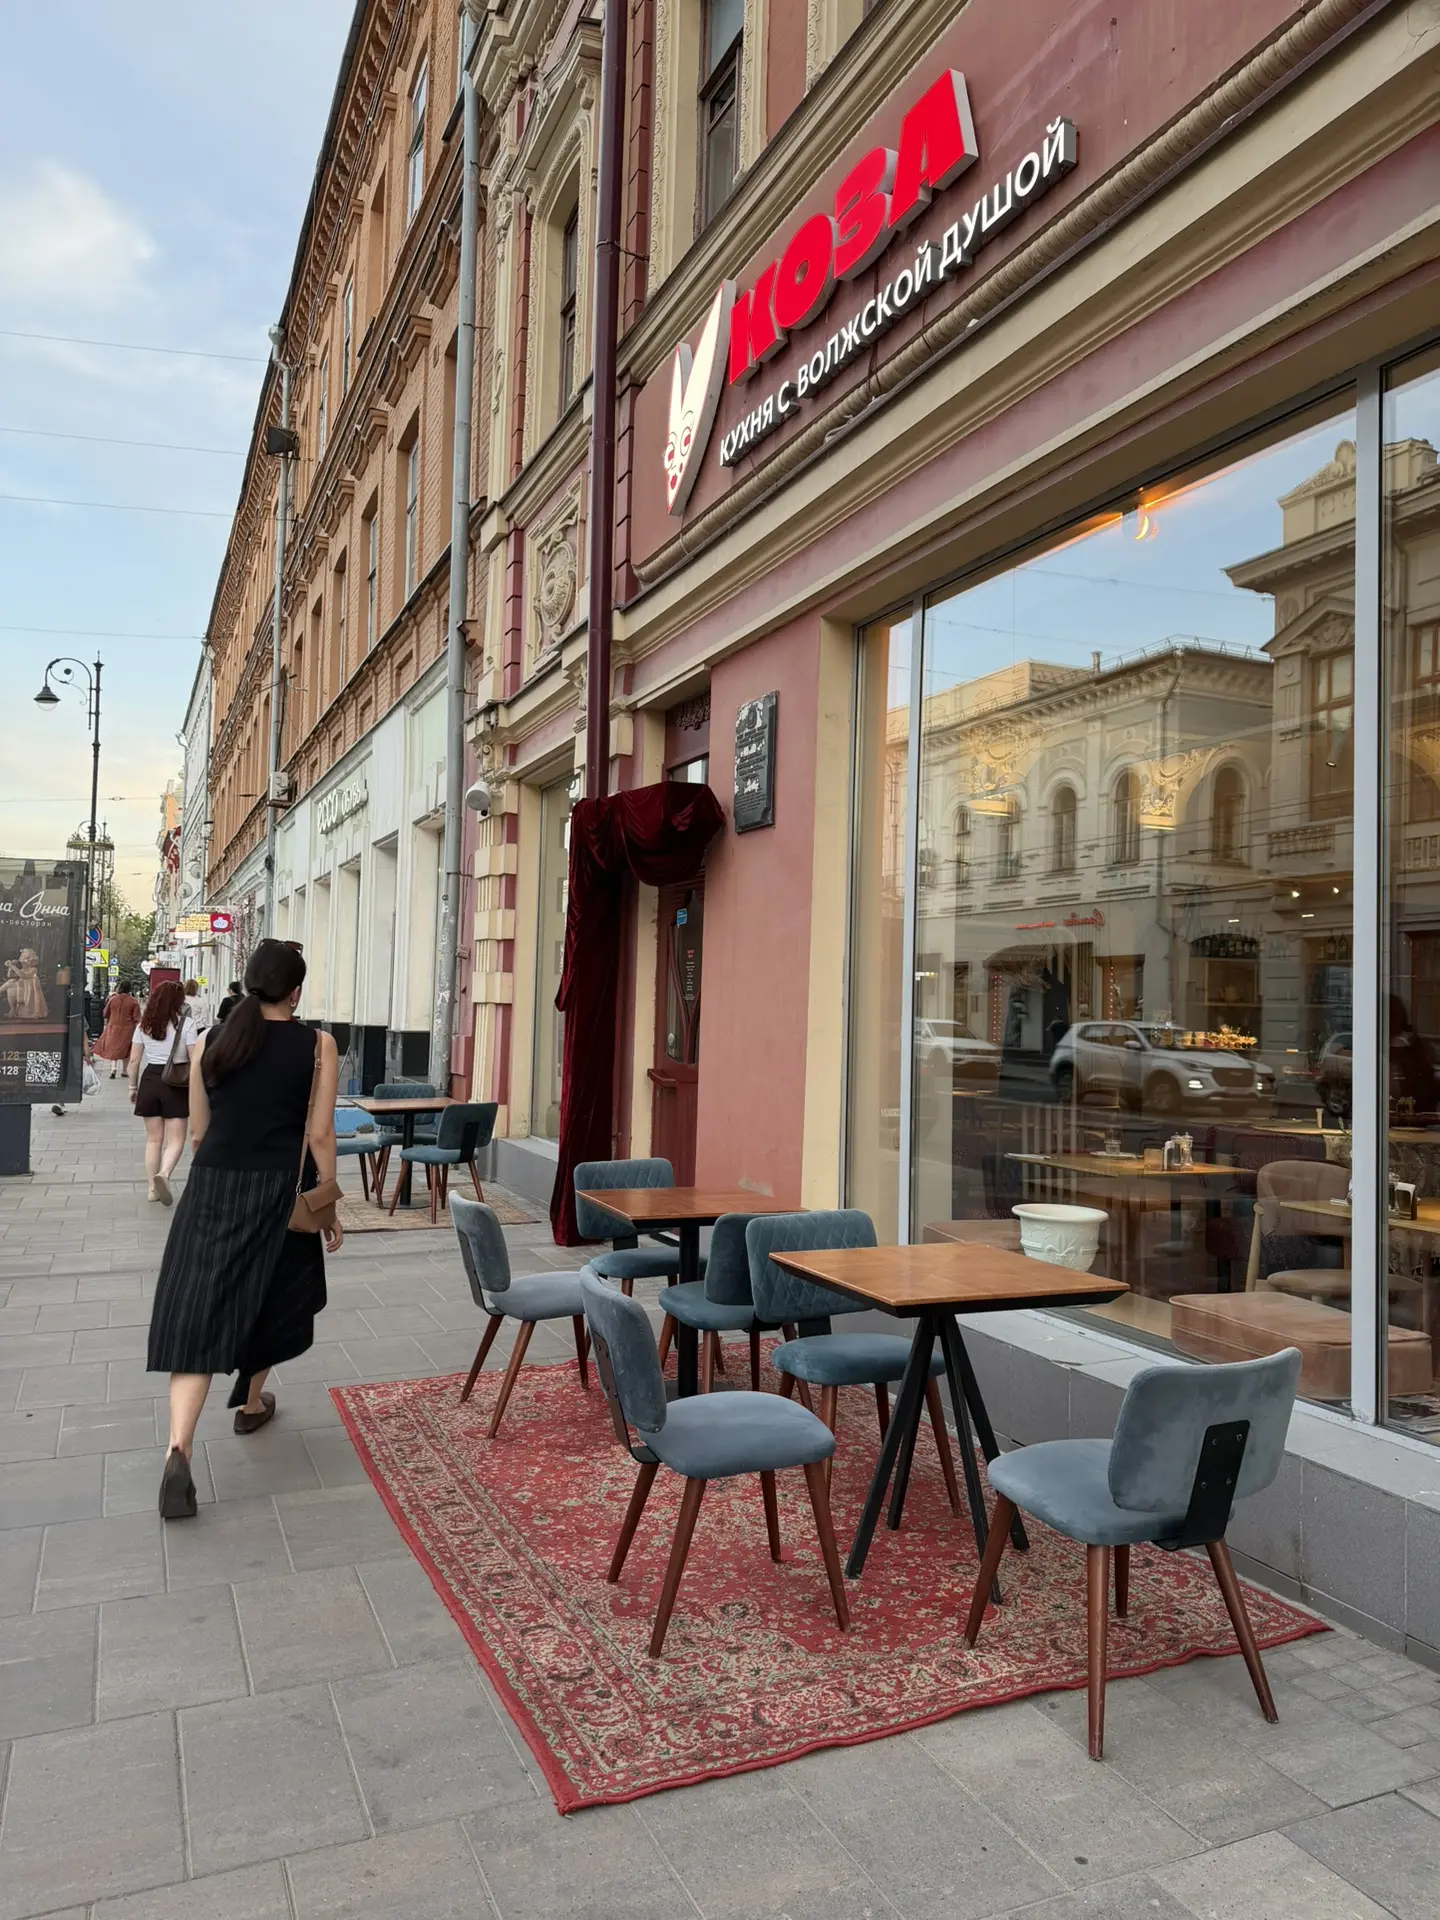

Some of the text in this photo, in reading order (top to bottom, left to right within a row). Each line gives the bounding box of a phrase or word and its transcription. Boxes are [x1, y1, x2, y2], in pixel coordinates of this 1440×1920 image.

[719, 115, 1067, 467] КУХНЯ С ВОЛЖСКОЙ ДУШОЙ
[729, 68, 971, 385] КОЗА
